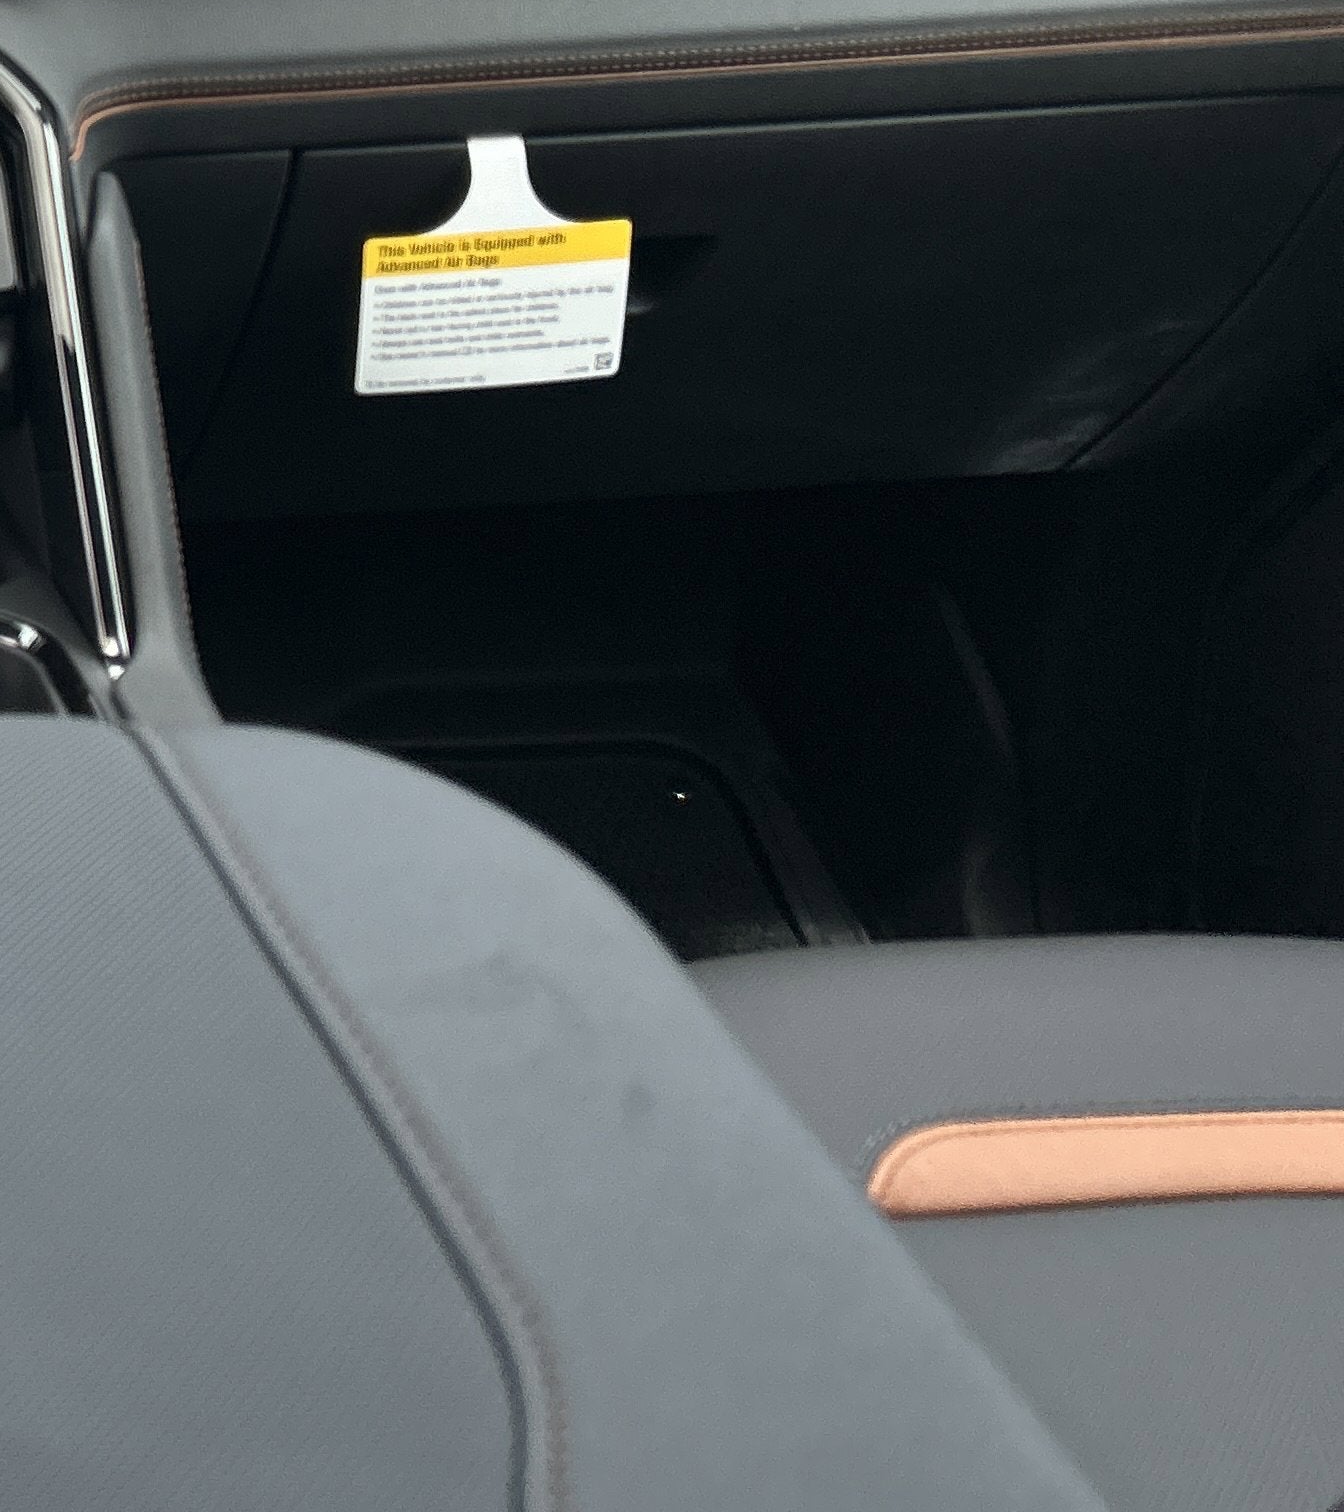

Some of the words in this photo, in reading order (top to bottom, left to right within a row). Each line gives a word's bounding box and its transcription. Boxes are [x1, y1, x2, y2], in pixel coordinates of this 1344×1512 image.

[378, 245, 405, 258] This
[408, 241, 455, 256] Vehicle
[459, 239, 470, 252] is
[474, 235, 534, 252] Equipped
[537, 233, 567, 247] with
[376, 257, 443, 273] Advanced
[444, 256, 463, 268] Air
[465, 254, 500, 270] Bags
